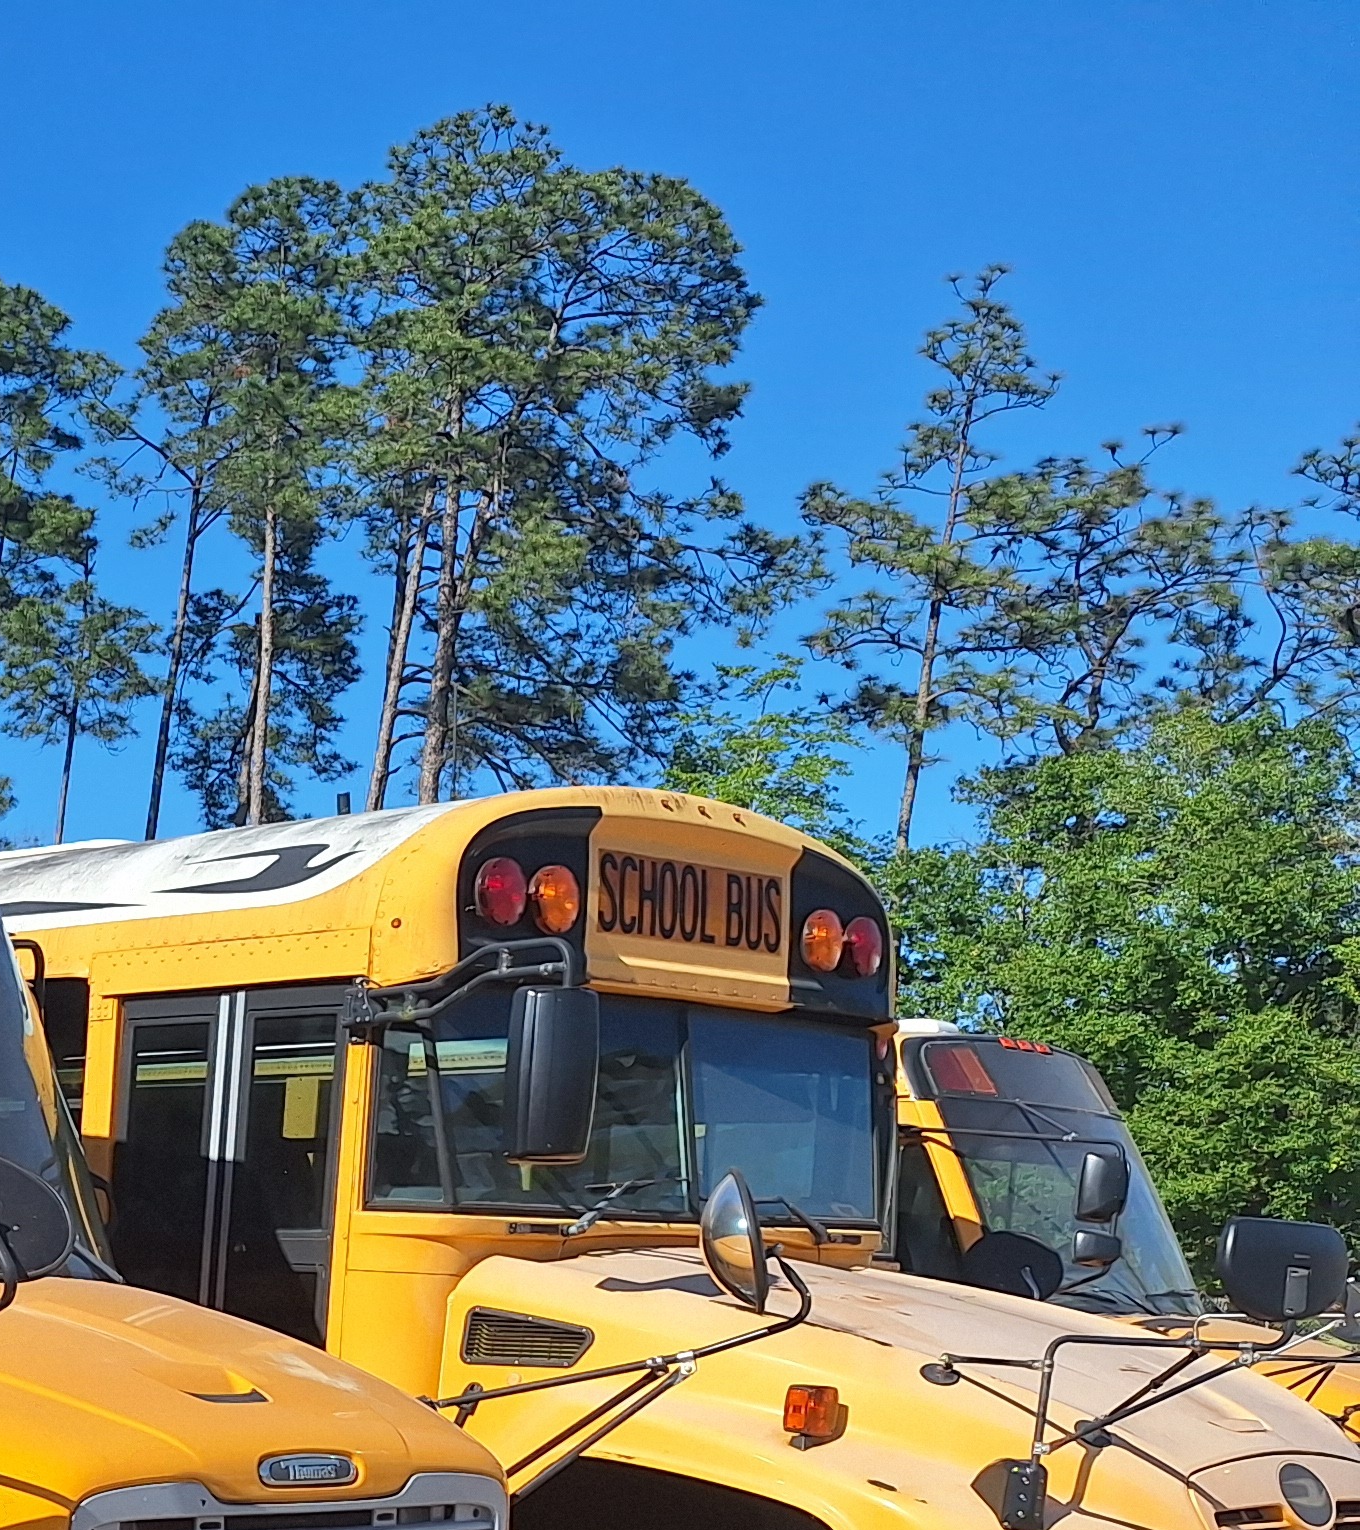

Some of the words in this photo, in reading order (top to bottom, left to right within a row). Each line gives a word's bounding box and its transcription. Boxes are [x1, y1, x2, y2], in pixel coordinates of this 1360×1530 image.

[597, 852, 715, 945] SCHOOL
[726, 872, 782, 954] BUS
[280, 1458, 340, 1480] Thomas
